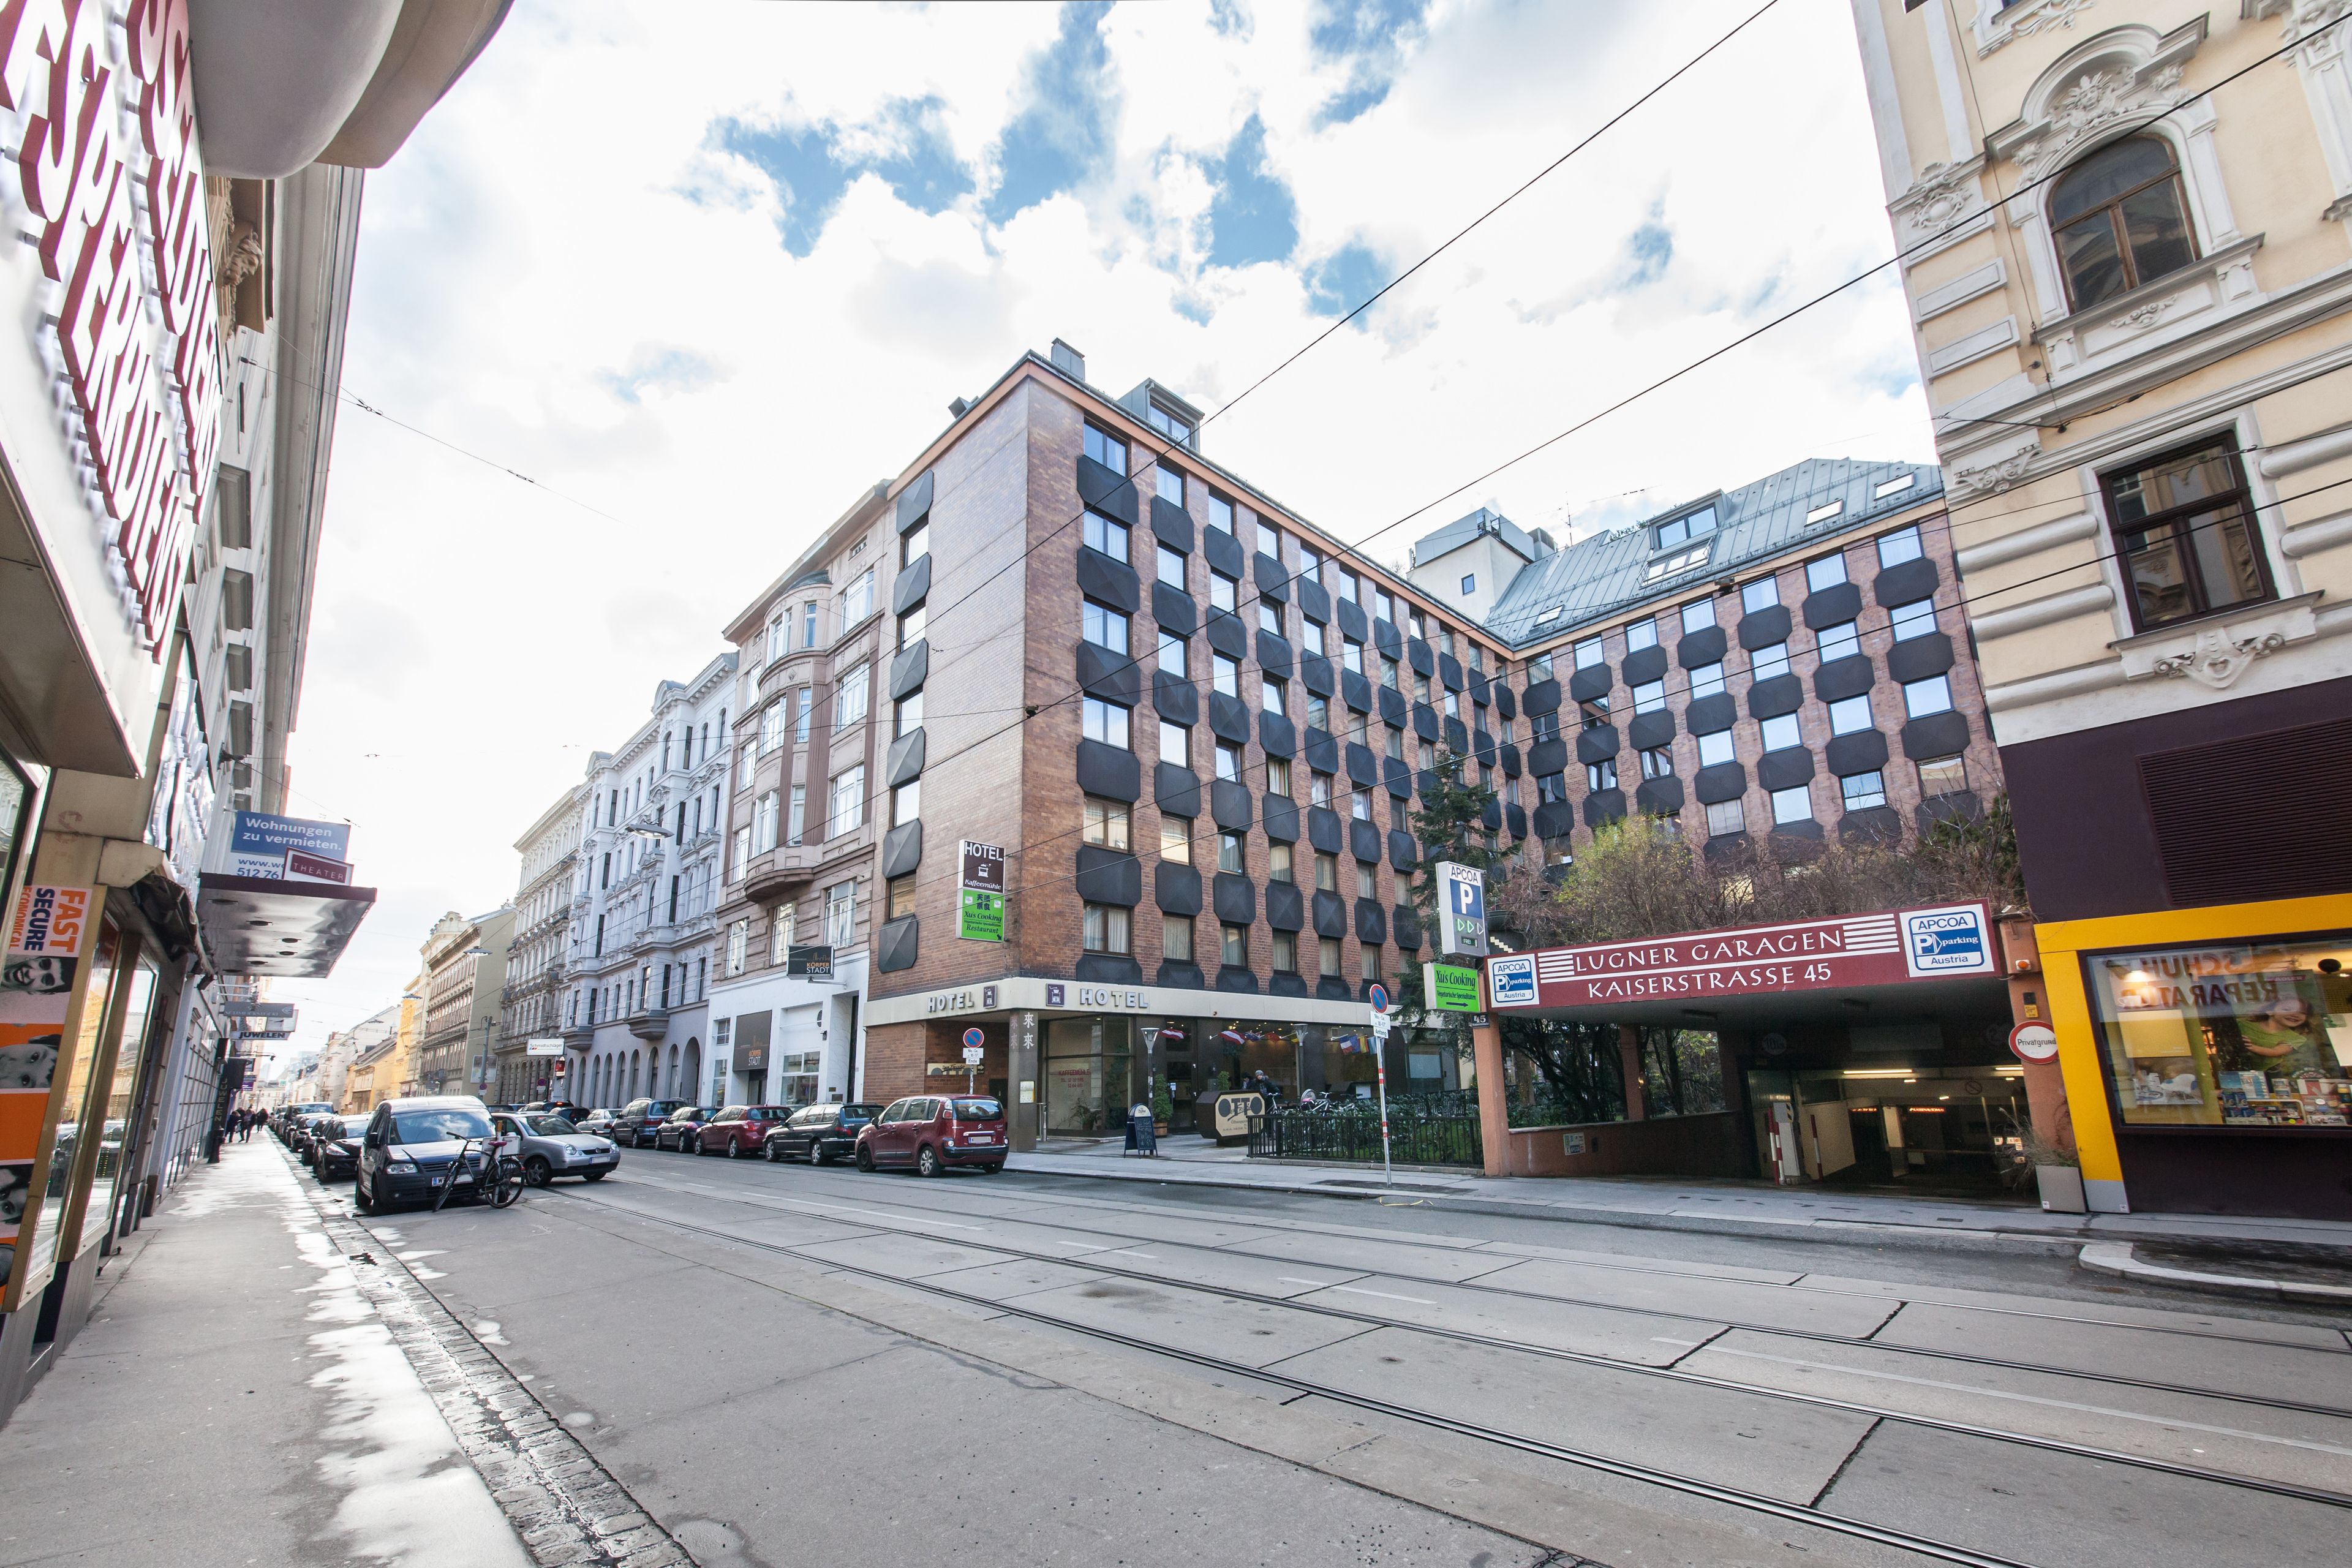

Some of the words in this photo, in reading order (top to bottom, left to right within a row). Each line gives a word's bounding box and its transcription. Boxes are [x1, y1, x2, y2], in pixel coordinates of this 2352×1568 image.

[246, 817, 332, 837] Wohnungen
[243, 832, 260, 841] zu
[265, 835, 342, 850] vermieten.
[965, 842, 1003, 861] HOTEL
[237, 867, 260, 878] 512
[293, 862, 344, 880] THEATER
[1451, 866, 1478, 883] APCOA
[965, 879, 1001, 889] Kaffeemühle
[1460, 882, 1473, 914] P
[24, 888, 55, 951] SECURE
[50, 890, 87, 952] FAST
[977, 913, 1002, 922] Cooking
[1918, 916, 1969, 930] APCOA
[967, 924, 998, 934] Restaurant
[1942, 937, 1978, 946] parking
[1576, 947, 1678, 972] LUGNER
[1692, 930, 1841, 962] GARAGEN
[1498, 963, 1526, 972] APCOA
[1931, 956, 1968, 965] Austria
[1436, 970, 1448, 983] Xu's
[1450, 972, 1476, 990] Cooking
[1589, 966, 1795, 998] KAISERSTRASSE
[1804, 962, 1831, 982] 45
[927, 992, 974, 1012] HOTEL
[1080, 989, 1148, 1008] HOTEL
[2018, 1038, 2056, 1047] Privatgrund
[748, 1057, 761, 1066] STADT
[215, 1078, 228, 1121] JUWELEN
